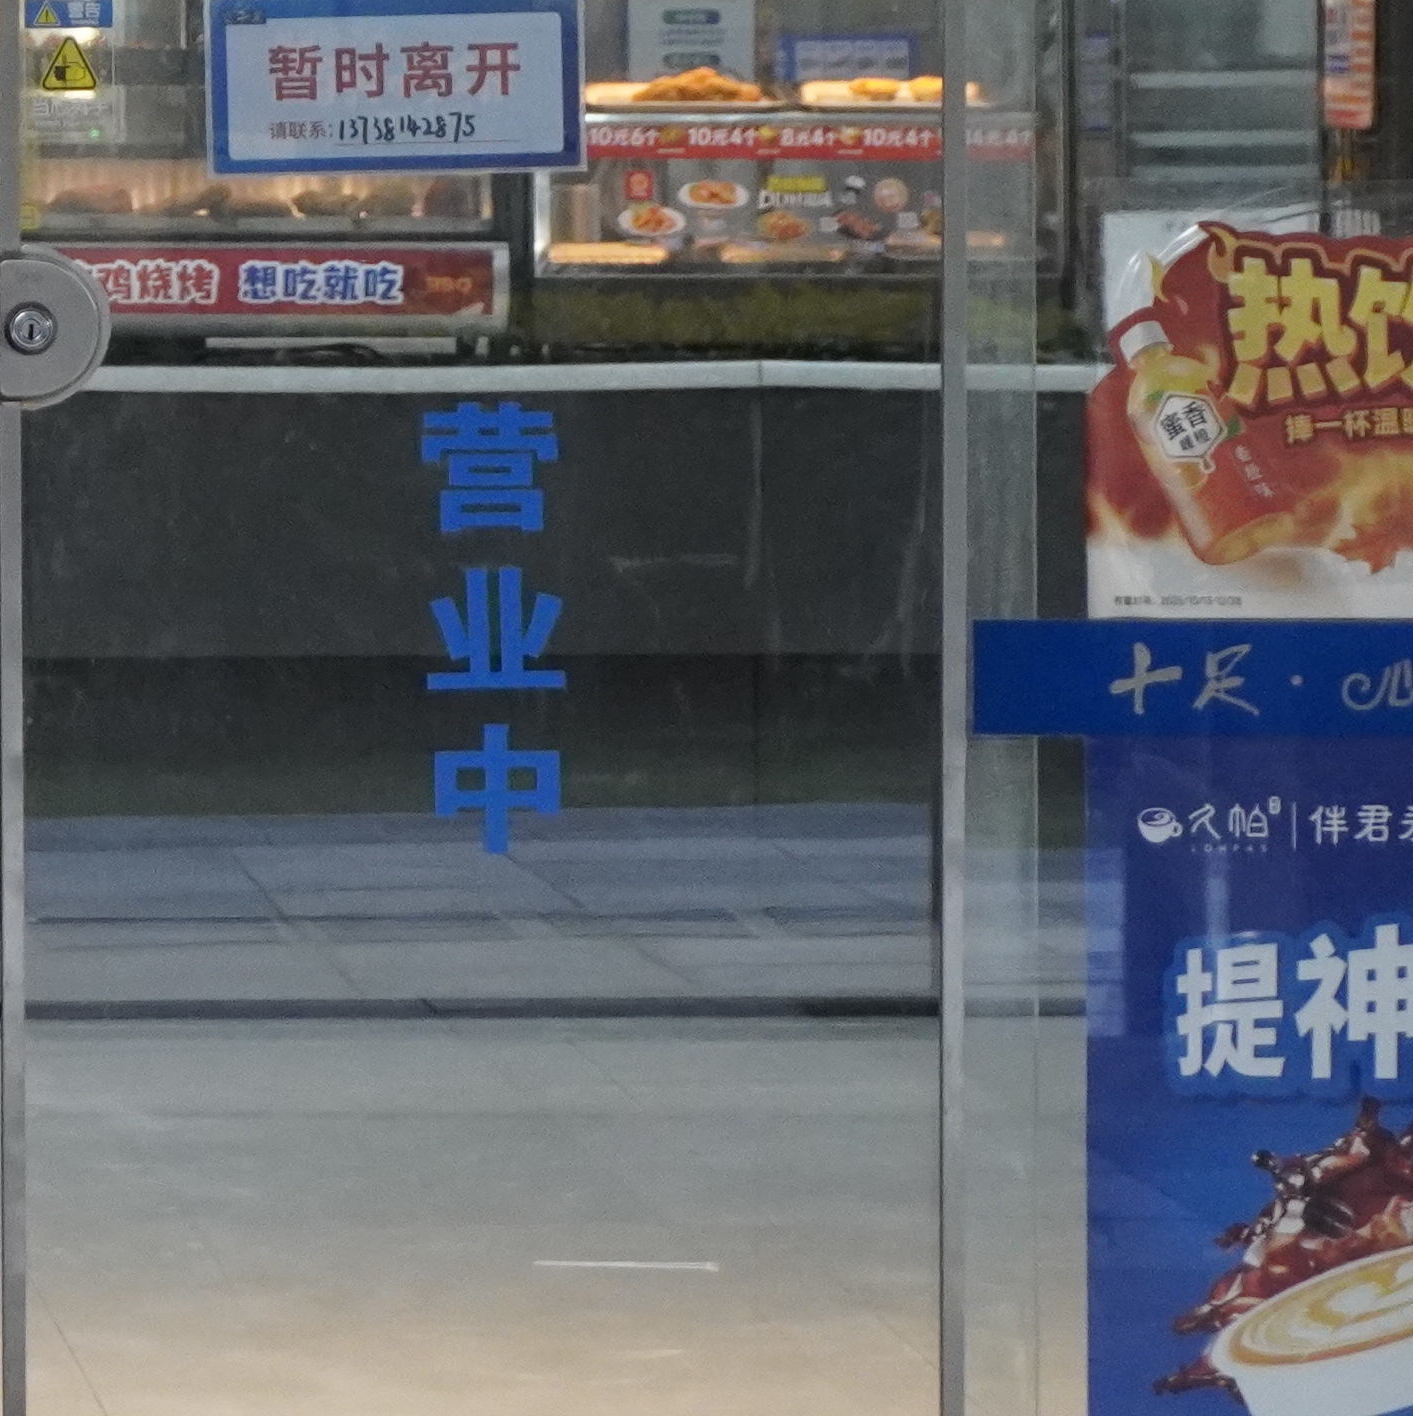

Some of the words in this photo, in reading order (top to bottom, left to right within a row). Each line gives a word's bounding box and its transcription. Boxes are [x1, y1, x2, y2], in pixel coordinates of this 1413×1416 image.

[268, 41, 521, 101] 暂时离开
[77, 260, 219, 304] 鸡烧烤
[239, 261, 404, 304] 想吃就吃
[421, 402, 565, 854] 营业中
[1110, 642, 1260, 716] 十足
[1176, 924, 1413, 1080] 提神
